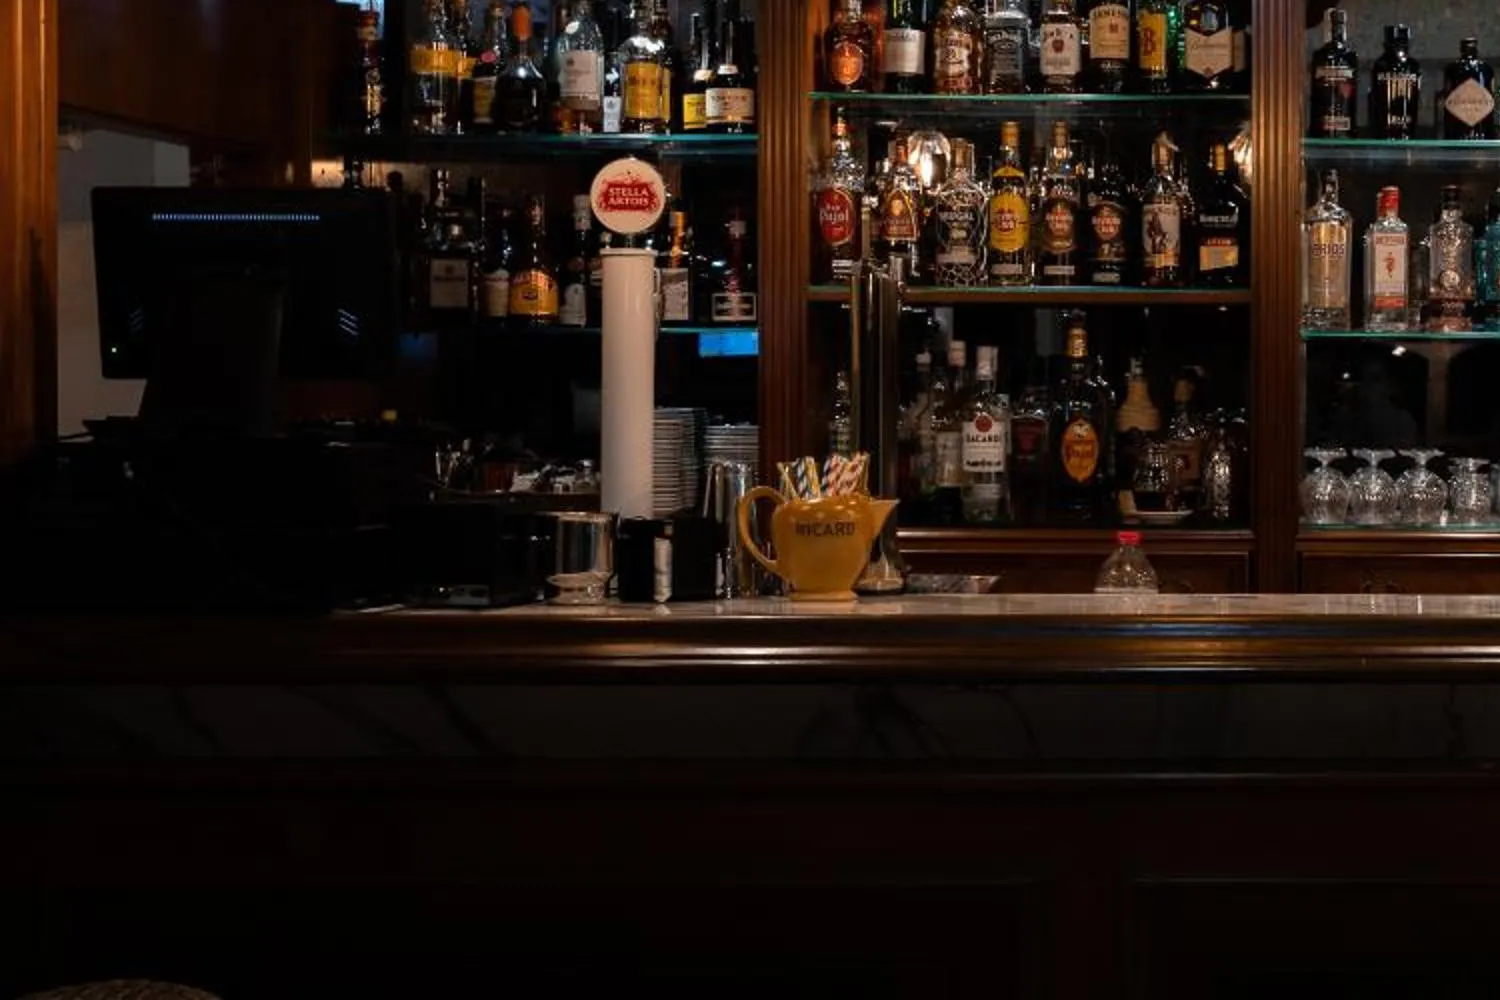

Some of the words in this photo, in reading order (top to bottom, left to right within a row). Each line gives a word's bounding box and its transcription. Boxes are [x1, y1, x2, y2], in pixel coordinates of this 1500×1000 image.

[608, 186, 650, 197] STELLA
[608, 196, 650, 207] ARTOIS
[795, 520, 856, 538] RICARD
